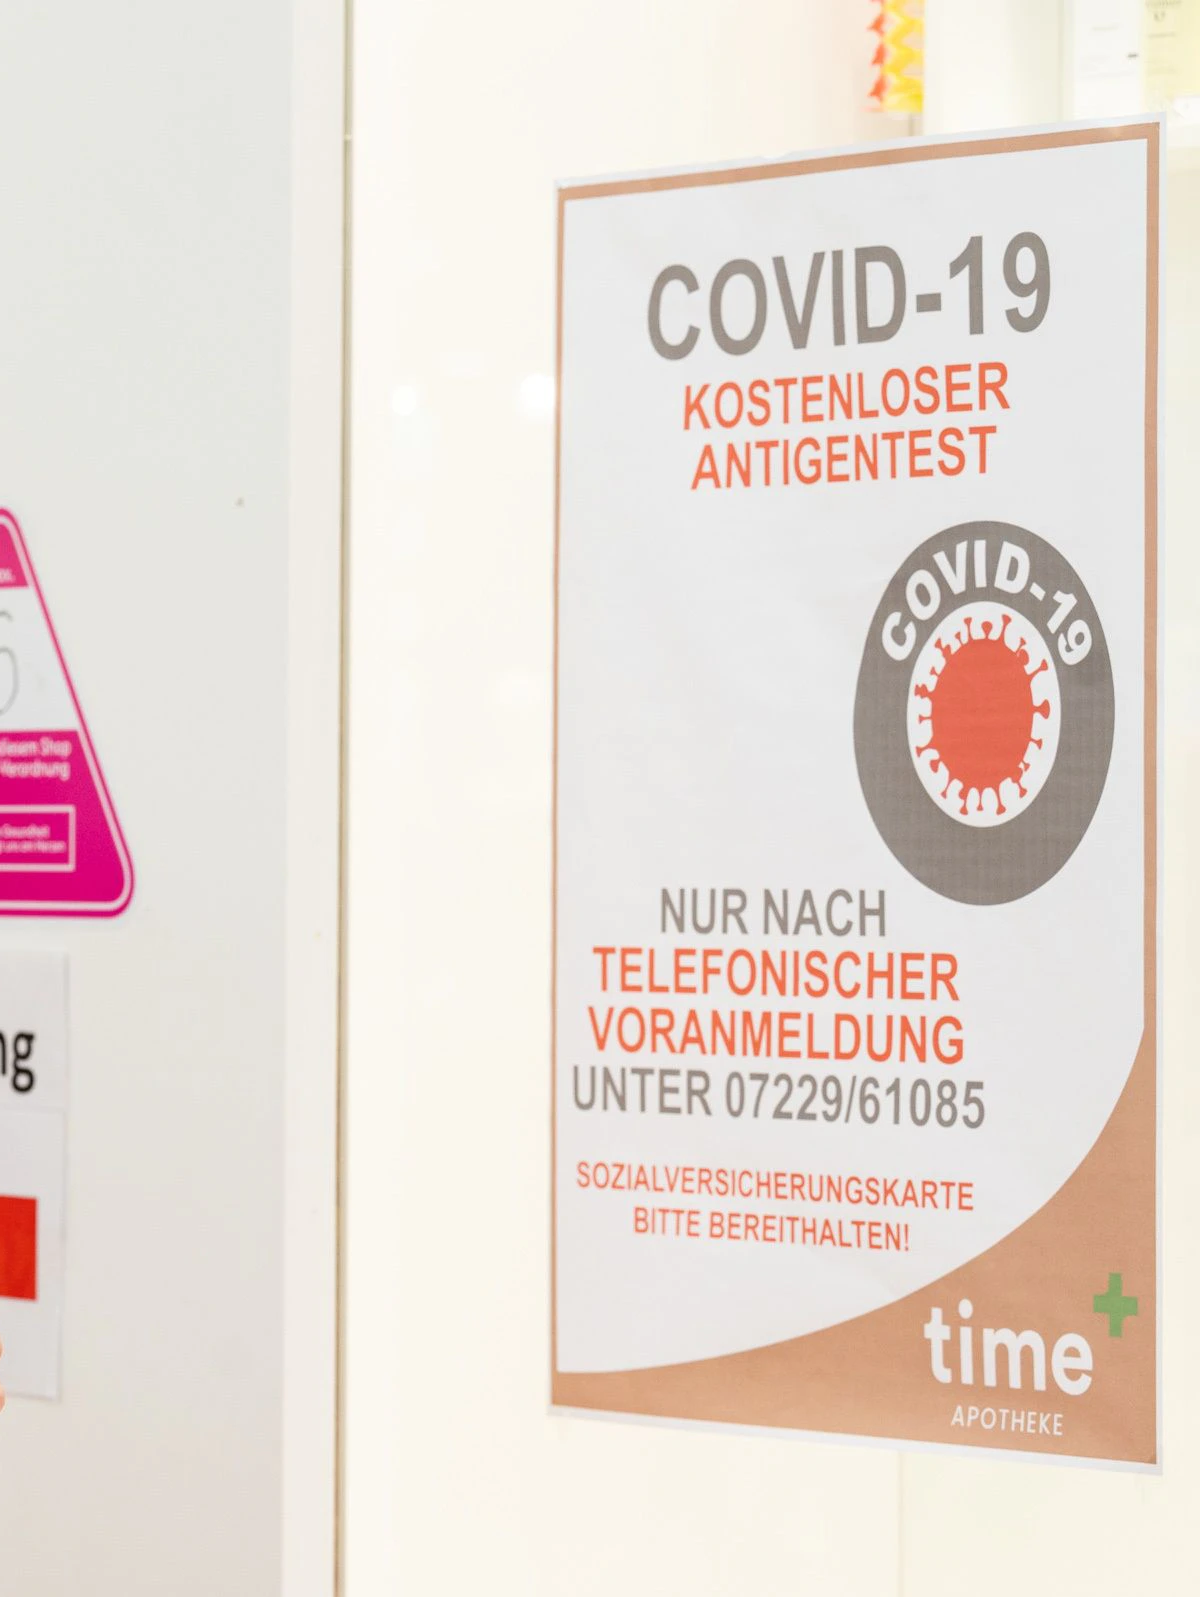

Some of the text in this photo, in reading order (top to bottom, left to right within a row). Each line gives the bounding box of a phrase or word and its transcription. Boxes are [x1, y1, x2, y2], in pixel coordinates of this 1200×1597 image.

[647, 230, 1052, 361] COVID-19
[683, 361, 1011, 430] KOSTENLOSER
[691, 425, 998, 490] ANTIGENTEST
[881, 539, 1093, 667] COVID-19
[659, 888, 887, 937] NUR NACH
[593, 946, 960, 1002] TELEFONISCHER
[588, 1006, 965, 1065] VORANMELDUNG
[572, 1065, 986, 1129] UNTER 07229/61085
[576, 1161, 974, 1211] SOZIALVERSICHERUNGSKARTE
[633, 1207, 911, 1252] BITTE BEREITHALTEN!
[924, 1298, 1093, 1396] time
[951, 1405, 1064, 1436] APOTHEKE
